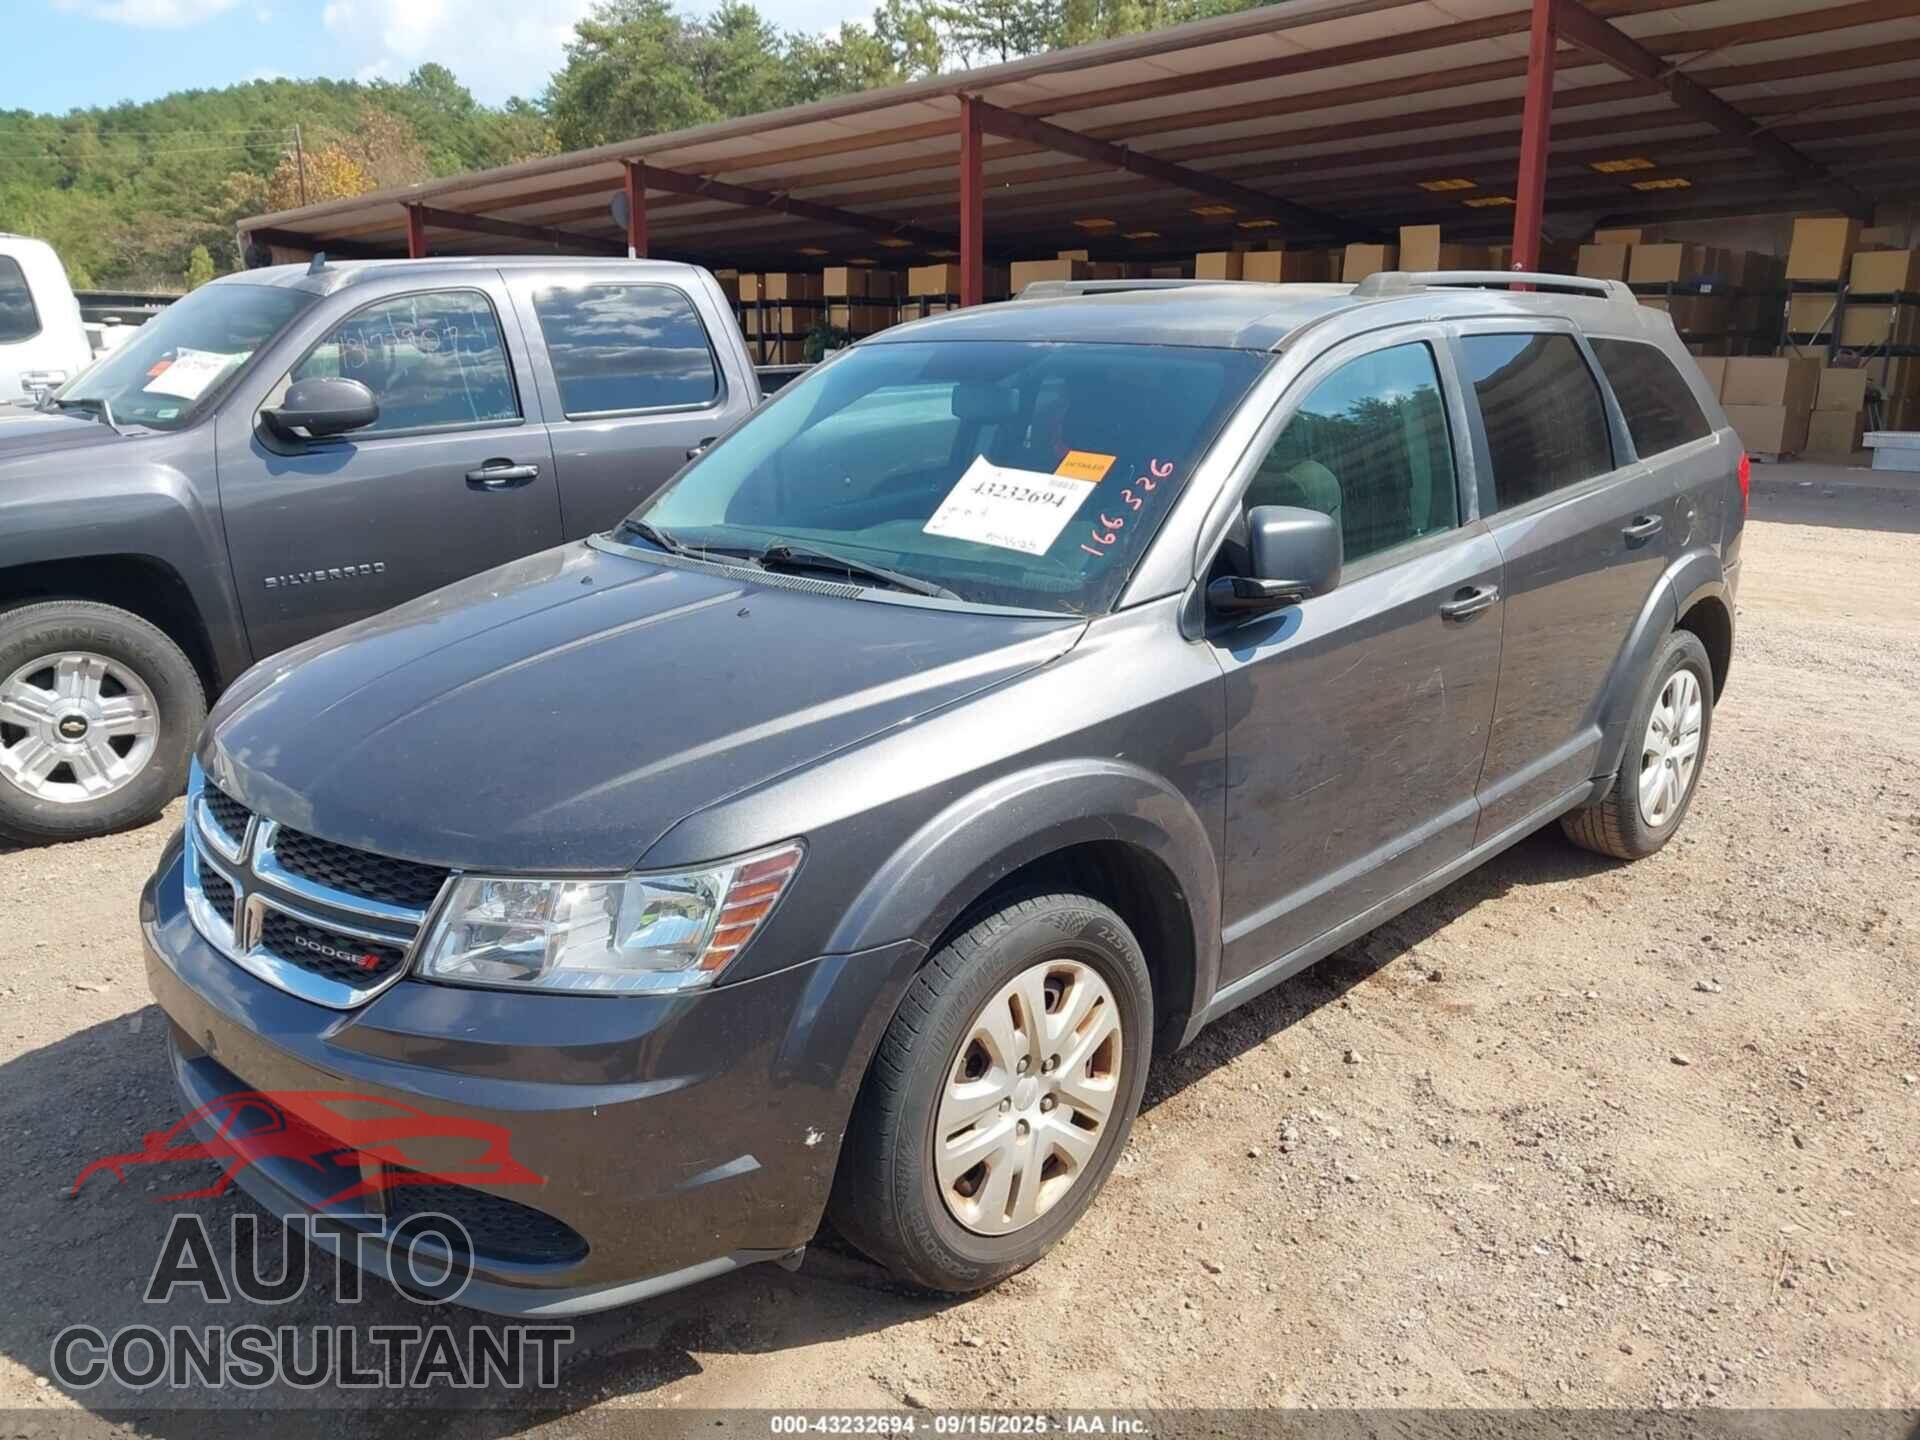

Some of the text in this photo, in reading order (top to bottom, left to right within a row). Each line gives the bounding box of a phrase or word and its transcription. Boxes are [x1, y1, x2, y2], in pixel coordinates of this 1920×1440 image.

[970, 481, 1067, 508] 43232694
[1080, 512, 1124, 556] 166
[264, 561, 385, 589] SILVERADO
[295, 935, 368, 966] DODGE
